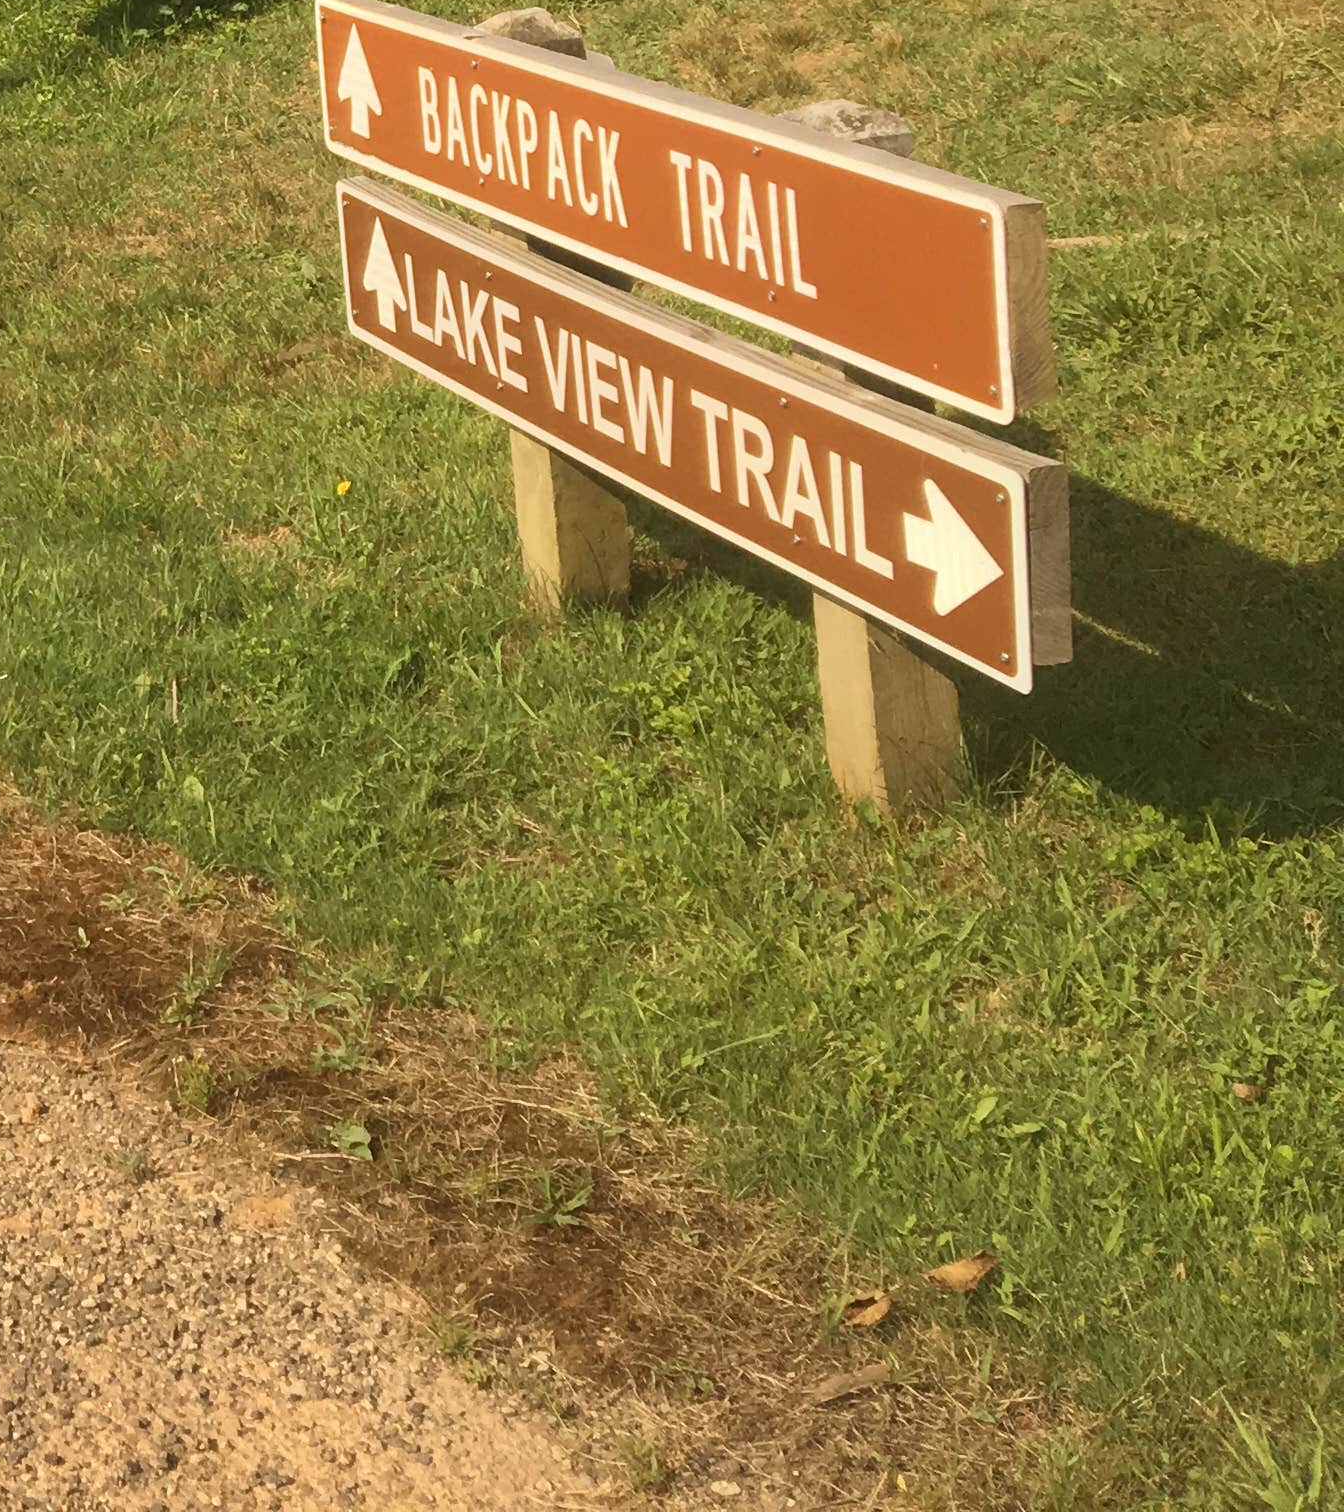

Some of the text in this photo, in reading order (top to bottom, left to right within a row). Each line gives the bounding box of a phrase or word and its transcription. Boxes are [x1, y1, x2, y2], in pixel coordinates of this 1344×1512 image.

[417, 65, 819, 300] BACKPACK TRAIL
[402, 254, 895, 581] LAKE VIEW TRAIL
